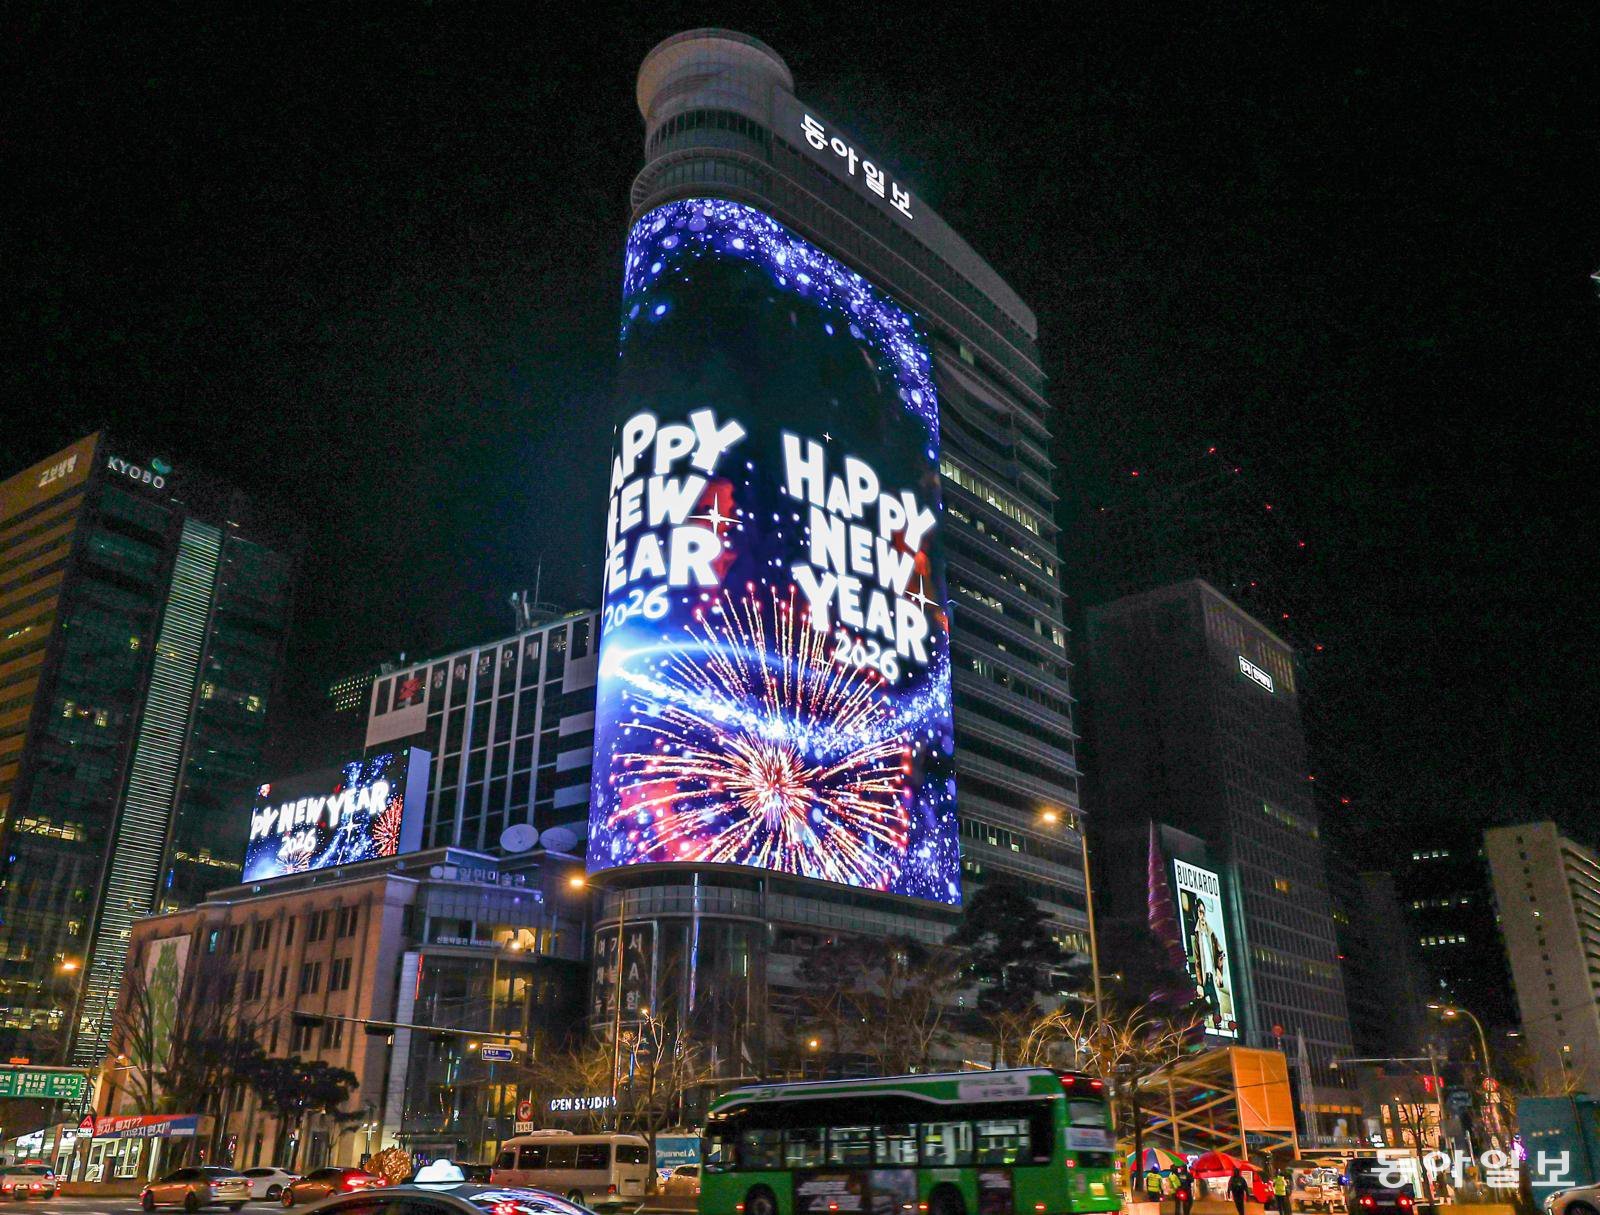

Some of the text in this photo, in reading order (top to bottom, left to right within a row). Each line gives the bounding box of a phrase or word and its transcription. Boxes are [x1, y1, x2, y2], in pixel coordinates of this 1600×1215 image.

[800, 113, 914, 220] 동아일보
[107, 456, 165, 488] KYOBO
[783, 433, 936, 553] HAPPY
[810, 505, 915, 597] NEW
[603, 585, 669, 637] 2026
[791, 564, 928, 663] YEAR
[835, 632, 901, 681] 2026
[277, 797, 327, 834] NEW
[325, 780, 391, 828] YEAR
[278, 828, 317, 856] 2026
[1176, 864, 1219, 897] BUCKAROO
[551, 1099, 572, 1111] OPEN
[656, 1148, 696, 1158] Channel A
